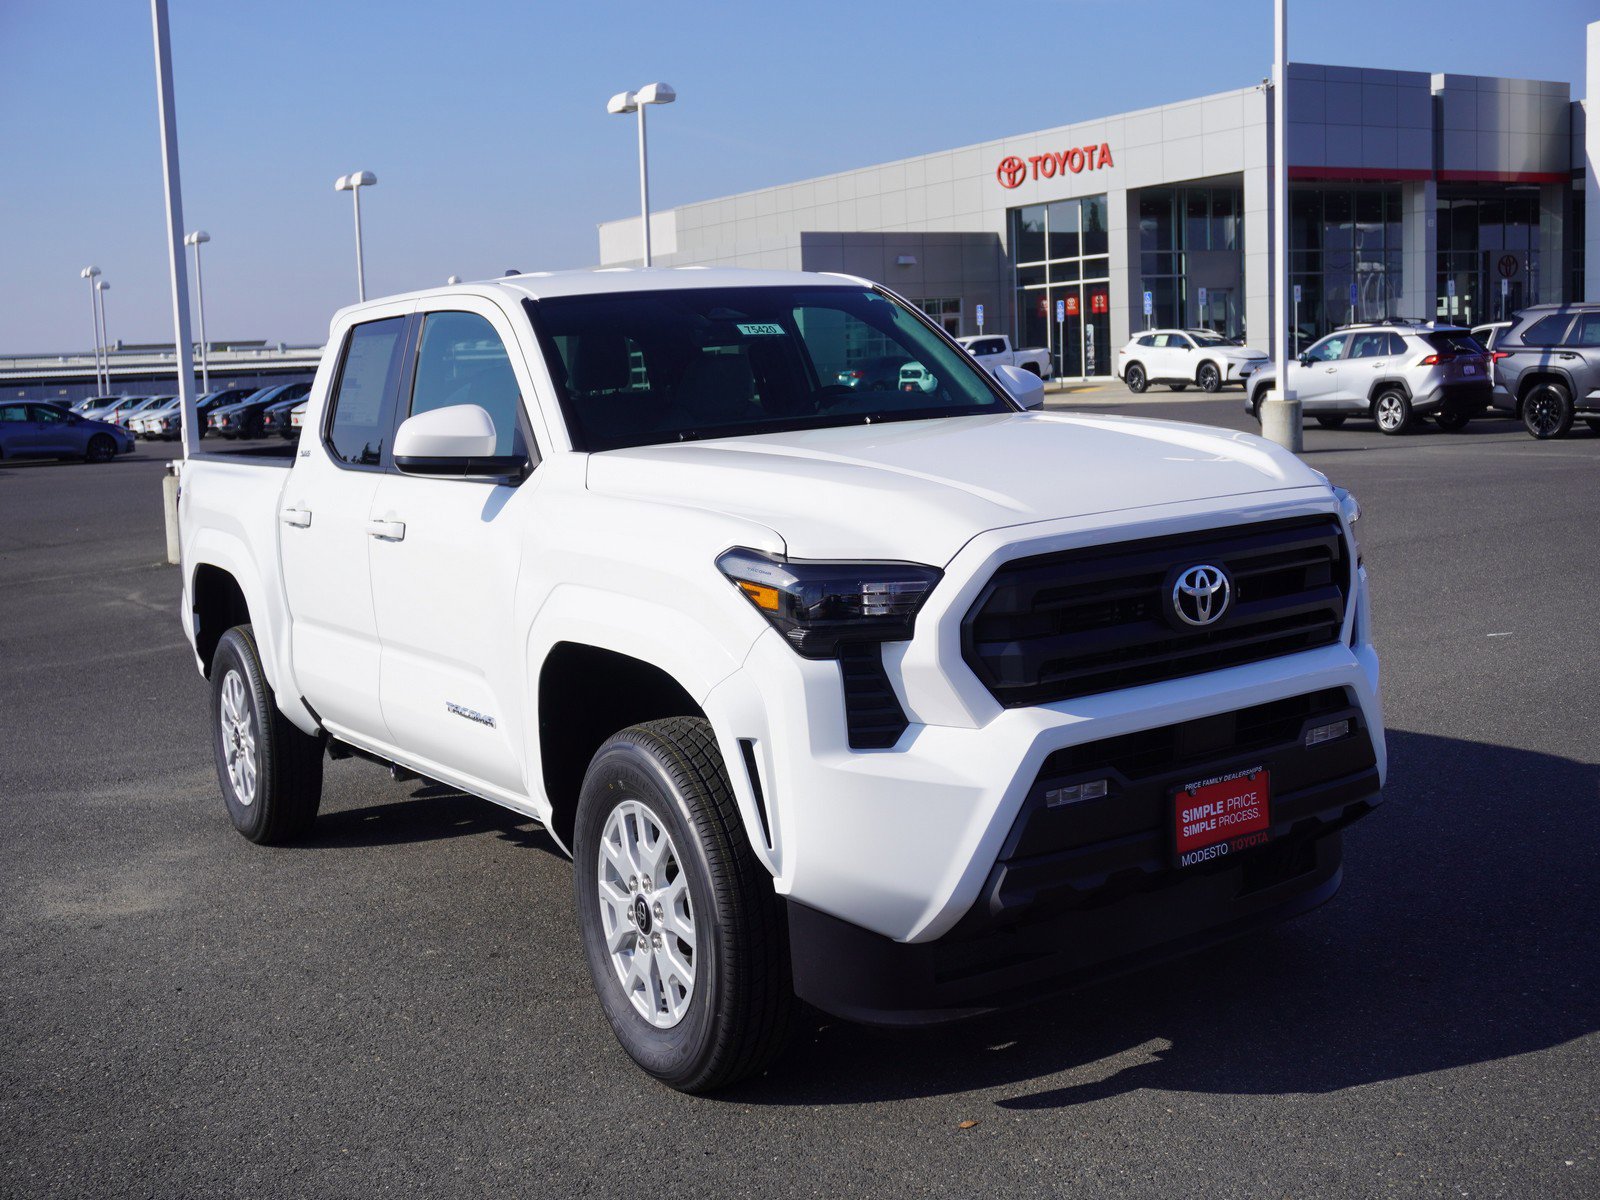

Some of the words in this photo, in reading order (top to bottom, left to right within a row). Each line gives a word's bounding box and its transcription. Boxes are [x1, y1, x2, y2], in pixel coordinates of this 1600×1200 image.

[1028, 142, 1114, 181] TOYOTA
[743, 325, 777, 334] 75420
[1184, 781, 1201, 791] PRICE
[1202, 776, 1223, 787] FAMILY
[1223, 766, 1263, 782] DEALERSHIPS
[1182, 801, 1224, 823] SIMPLE
[1227, 792, 1260, 812] PRICE.
[1183, 818, 1217, 838] SIMPLE
[1218, 807, 1261, 828] PROCESS.
[1181, 843, 1229, 867] MODESTO
[1231, 832, 1269, 853] TOYOTA
